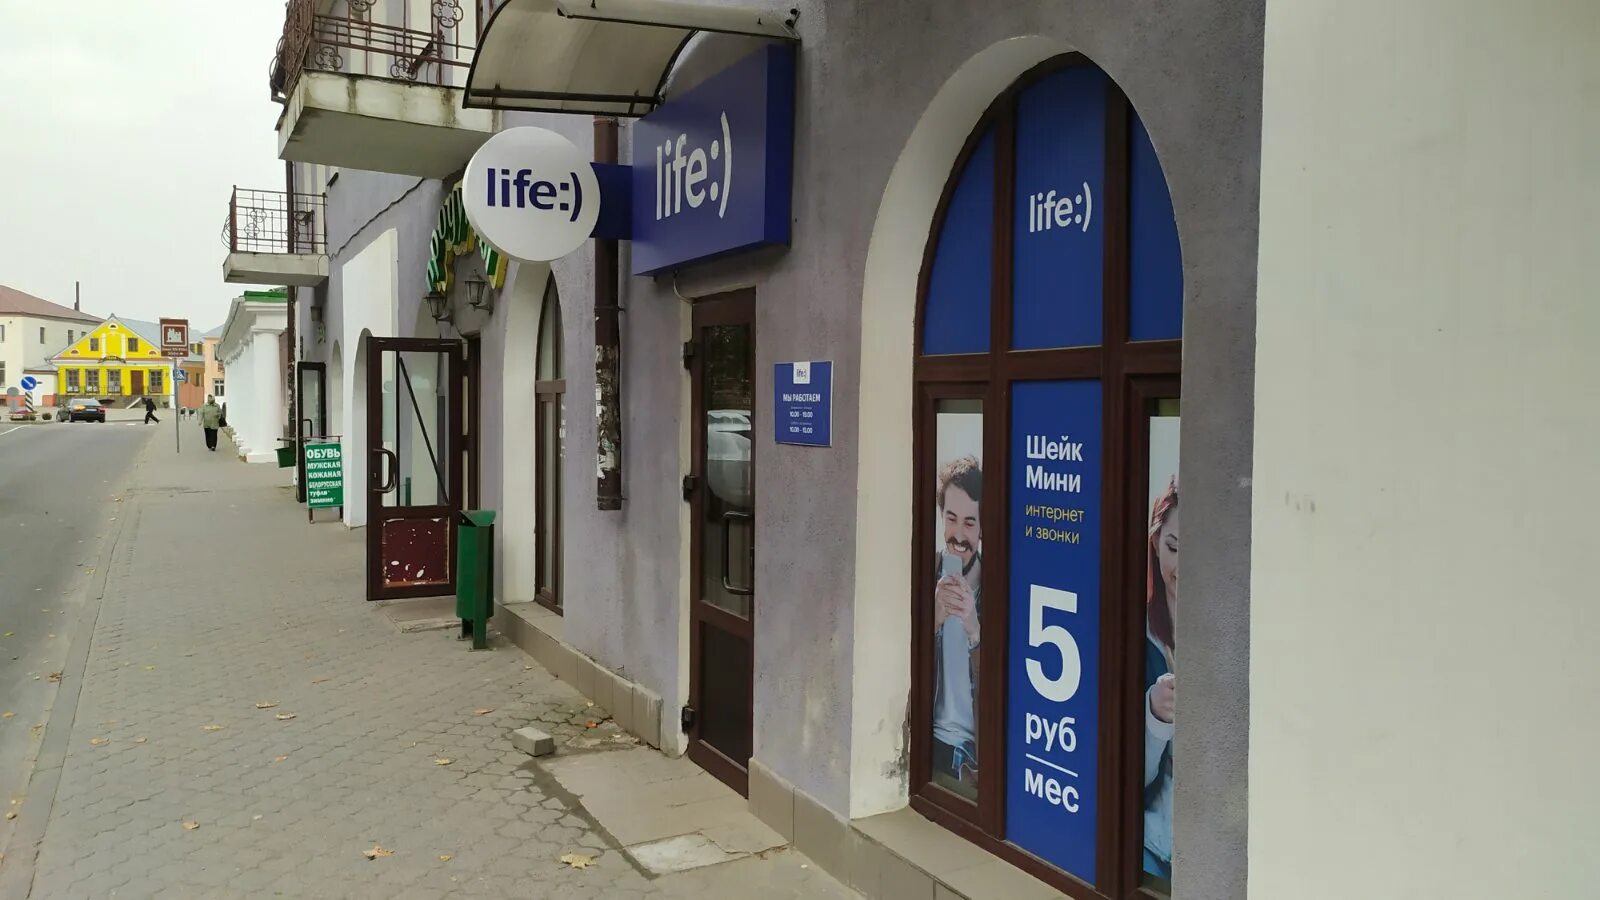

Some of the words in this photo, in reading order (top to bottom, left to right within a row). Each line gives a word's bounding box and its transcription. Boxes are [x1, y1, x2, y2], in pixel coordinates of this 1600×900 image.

[656, 110, 732, 221] life:)
[487, 167, 583, 222] life:)
[1029, 181, 1092, 233] life:)
[782, 393, 792, 402] МЫ
[793, 393, 821, 402] РАБОТАЕМ
[306, 448, 341, 459] ОБУВЬ
[1026, 435, 1083, 461] Шейк
[307, 461, 341, 469] МУЖСКАЯ
[308, 471, 342, 479] КОЖАНАЯ
[1026, 464, 1081, 493] Мини
[1025, 504, 1085, 523] интернет
[1025, 525, 1033, 537] и
[1035, 527, 1080, 544] звонки
[1025, 583, 1082, 702] 5
[1025, 712, 1077, 753] руб
[1024, 768, 1079, 813] мес
